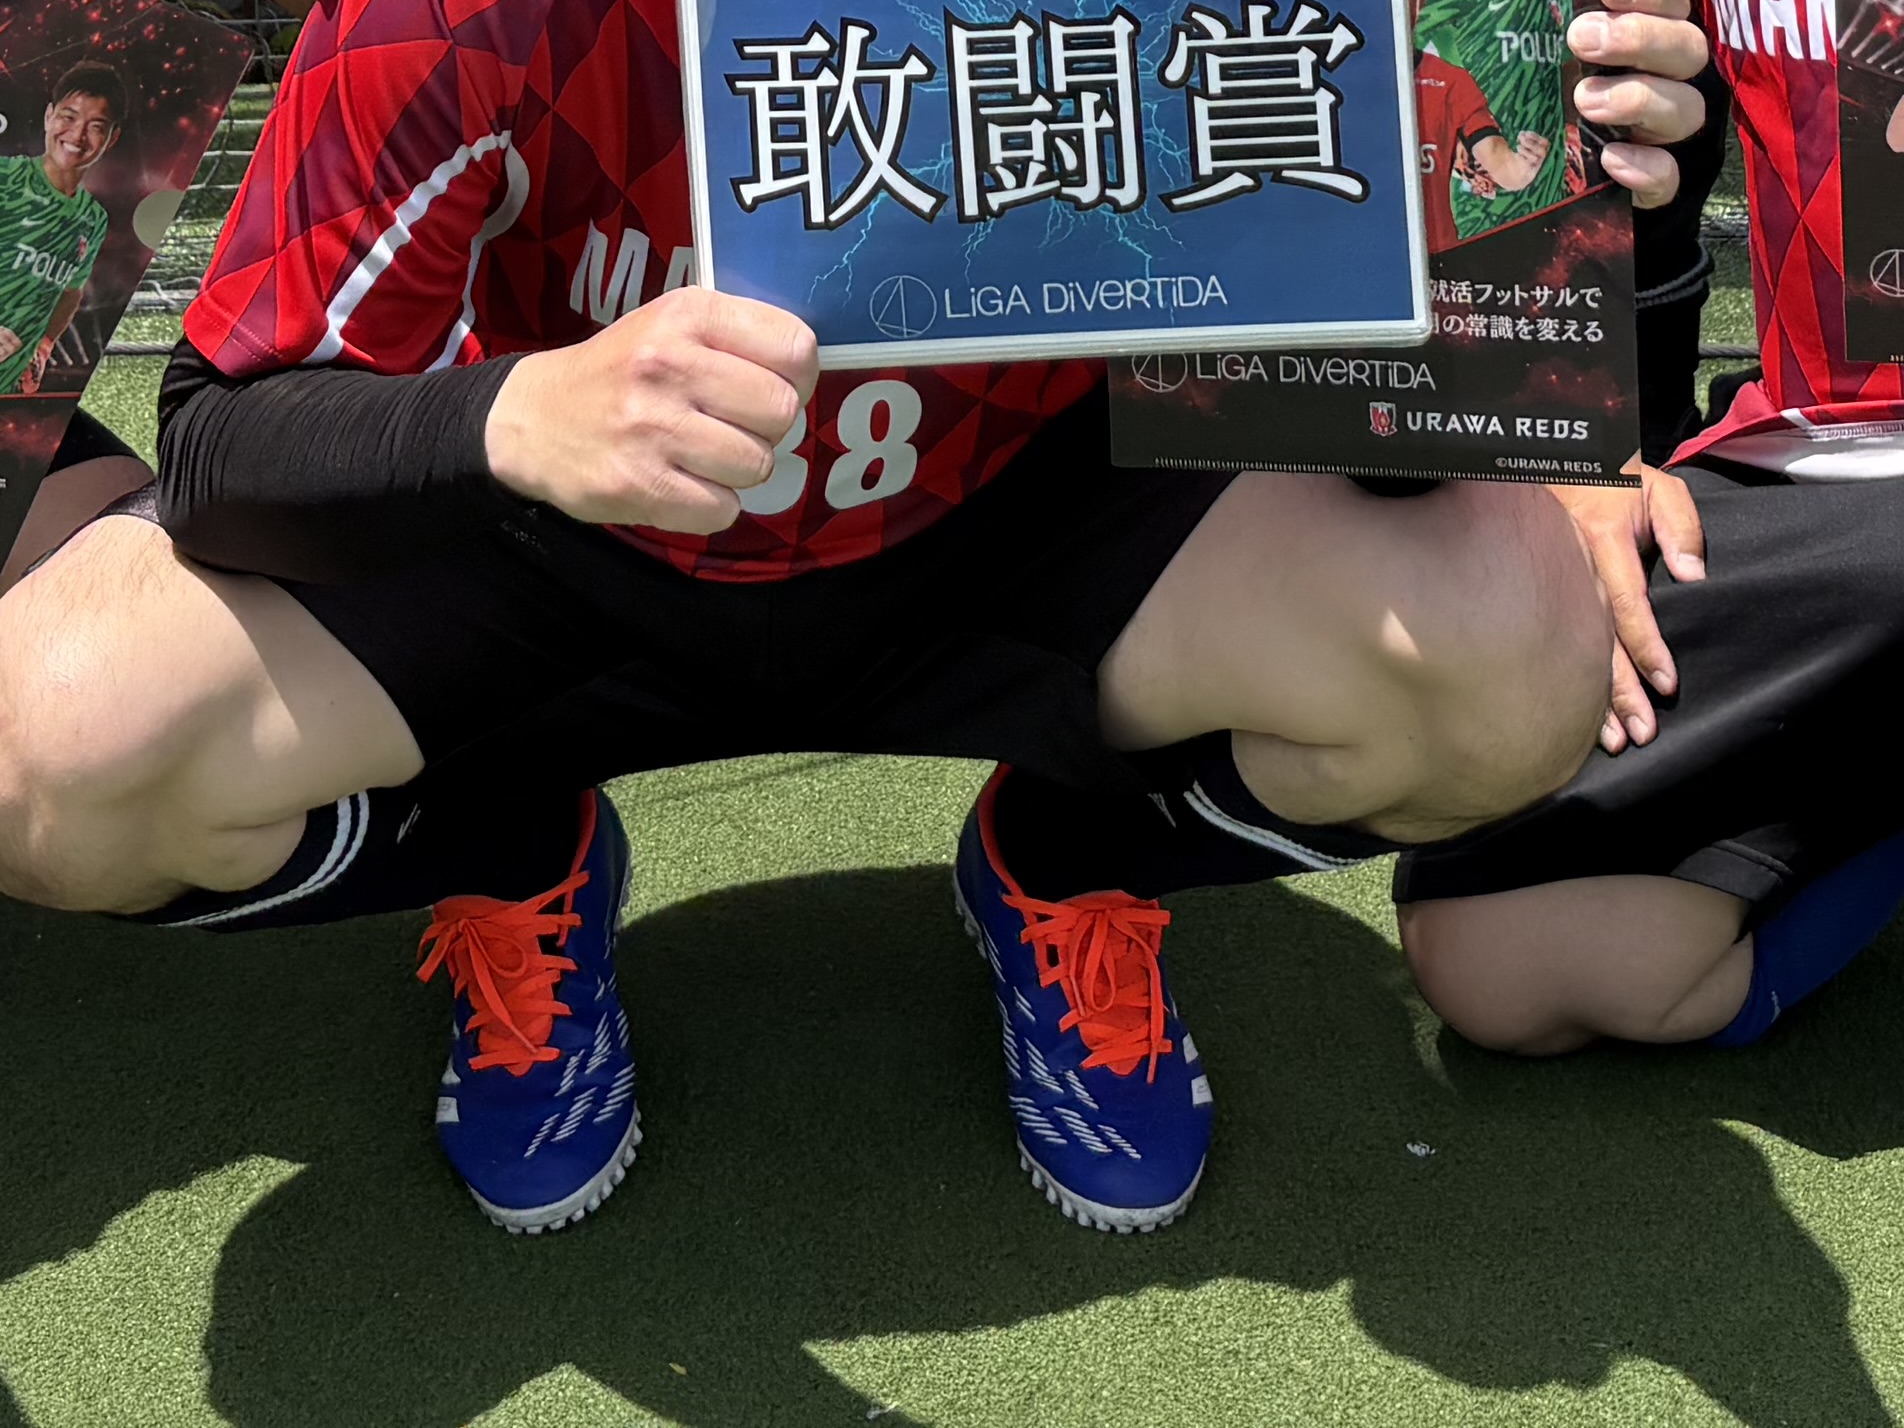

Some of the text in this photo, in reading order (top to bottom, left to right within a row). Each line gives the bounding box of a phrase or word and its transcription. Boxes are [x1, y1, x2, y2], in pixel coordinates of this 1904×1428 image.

[1432, 313, 1604, 343] の常識を変える
[1407, 410, 1589, 440] URAWA REDS
[1496, 457, 1602, 473] ©URAWA REDS
